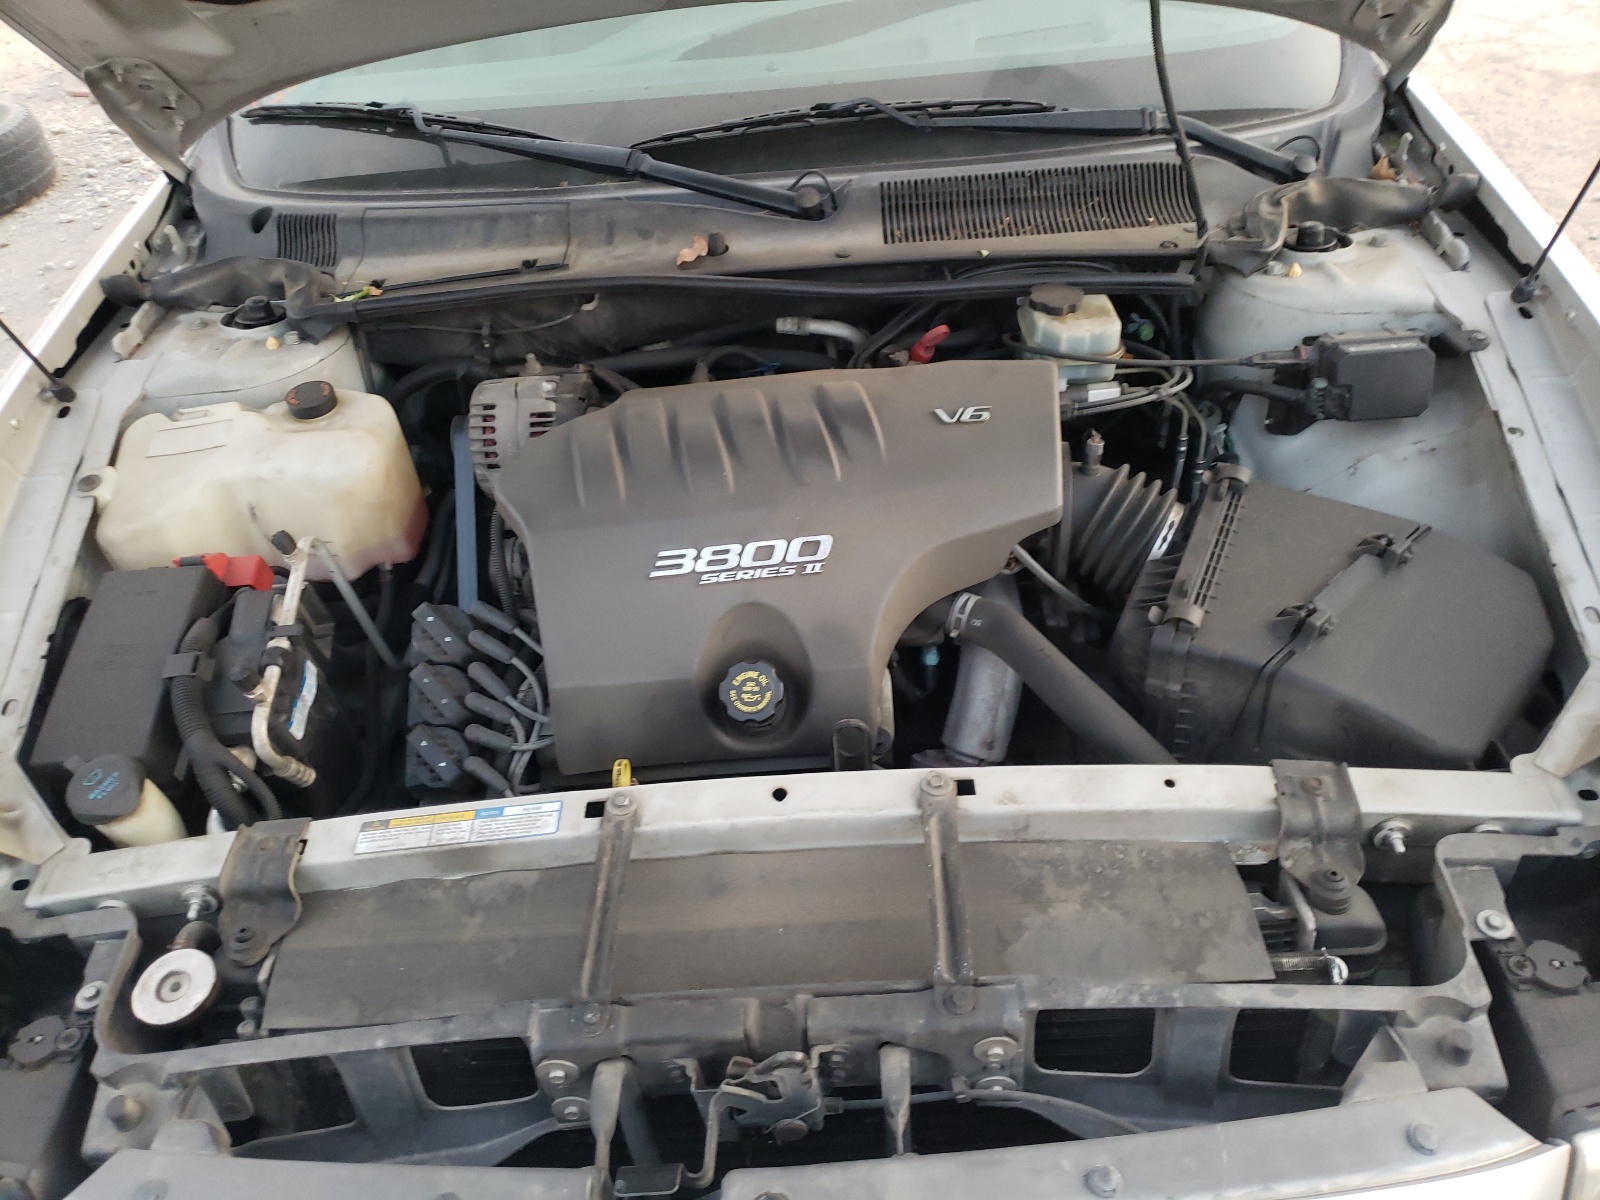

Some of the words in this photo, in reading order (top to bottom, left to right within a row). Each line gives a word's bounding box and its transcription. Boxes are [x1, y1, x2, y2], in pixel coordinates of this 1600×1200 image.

[933, 405, 992, 424] V6
[648, 534, 834, 578] 3800
[698, 565, 797, 585] SERIES
[801, 562, 826, 575] II
[758, 675, 770, 687] OIL
